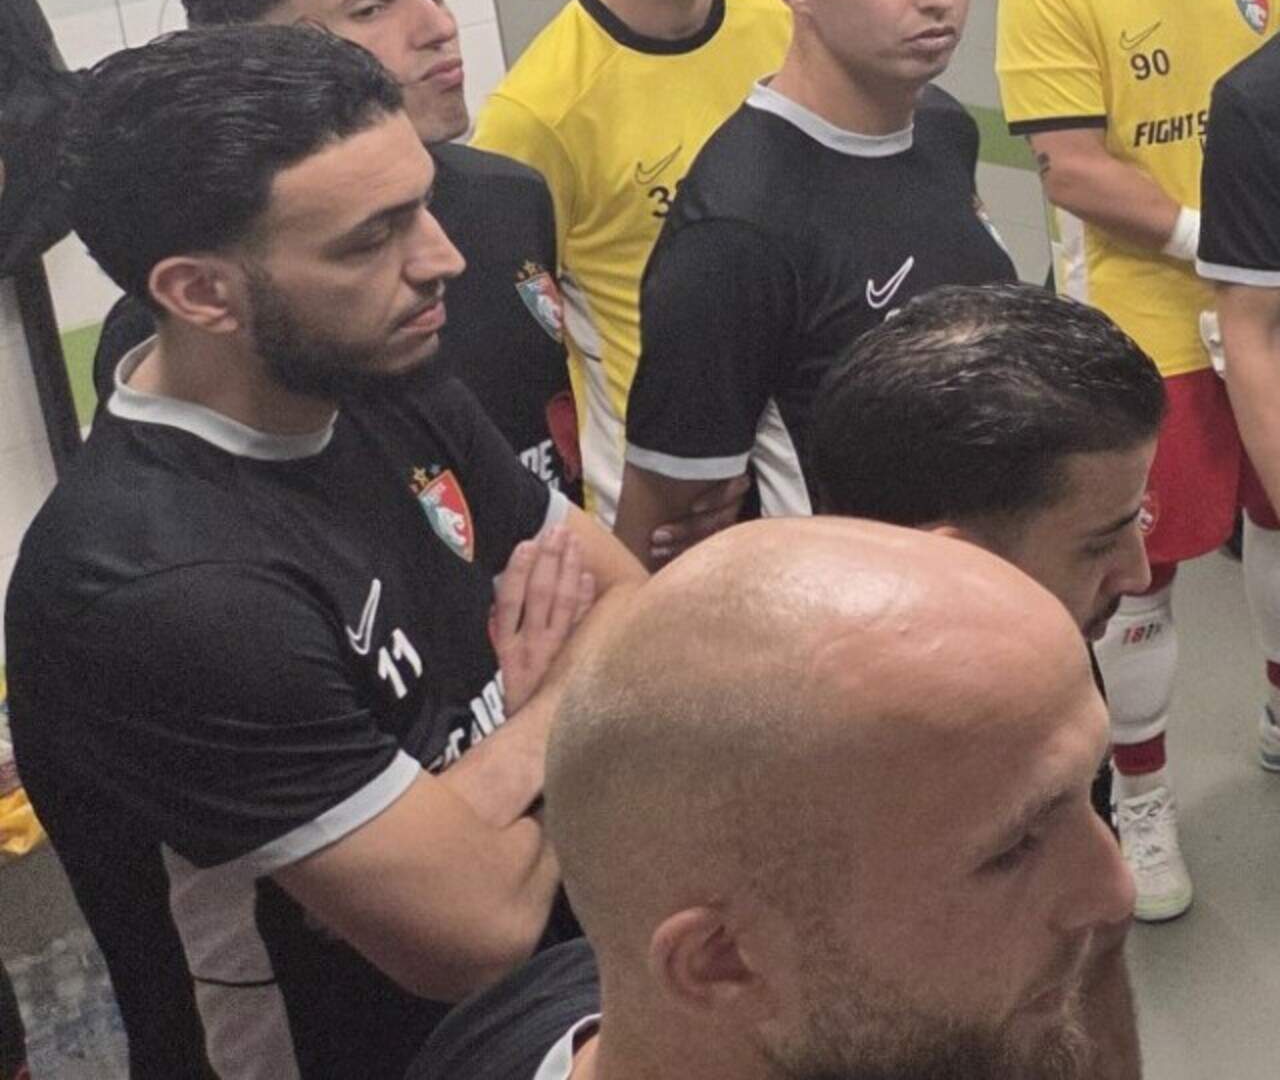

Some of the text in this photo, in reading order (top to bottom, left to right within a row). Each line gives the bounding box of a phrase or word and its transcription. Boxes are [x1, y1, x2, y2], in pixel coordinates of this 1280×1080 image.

[1130, 49, 1170, 80] 90
[1133, 113, 1193, 148] FIGHT
[648, 185, 674, 219] 3
[378, 628, 423, 699] 11
